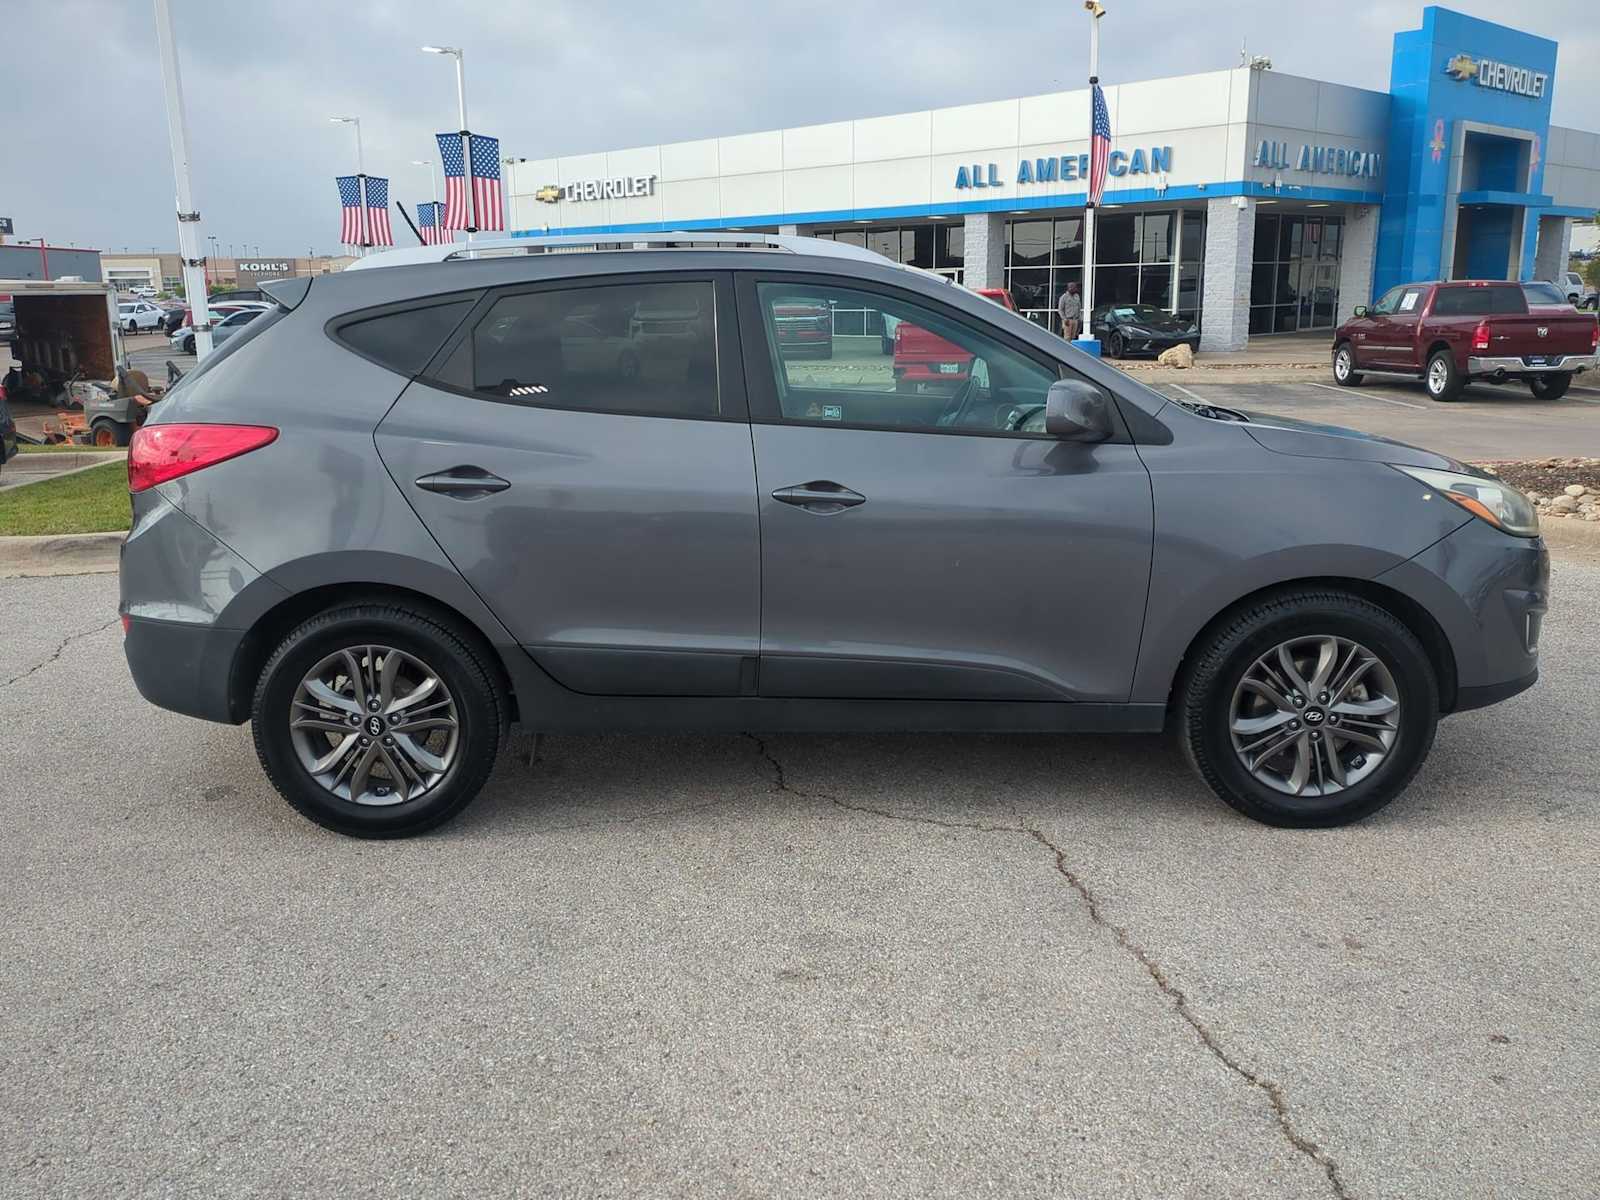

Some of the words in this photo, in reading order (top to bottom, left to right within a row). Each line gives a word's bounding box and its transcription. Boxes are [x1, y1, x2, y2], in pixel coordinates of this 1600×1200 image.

[1479, 60, 1548, 98] CHEVROLET
[955, 163, 1003, 189] ALL
[1017, 147, 1172, 184] AMERCAN
[1254, 140, 1289, 169] ALL
[1295, 144, 1382, 178] AMERICAN
[563, 175, 656, 202] CHEVROLET
[240, 263, 288, 271] KOHL'S
